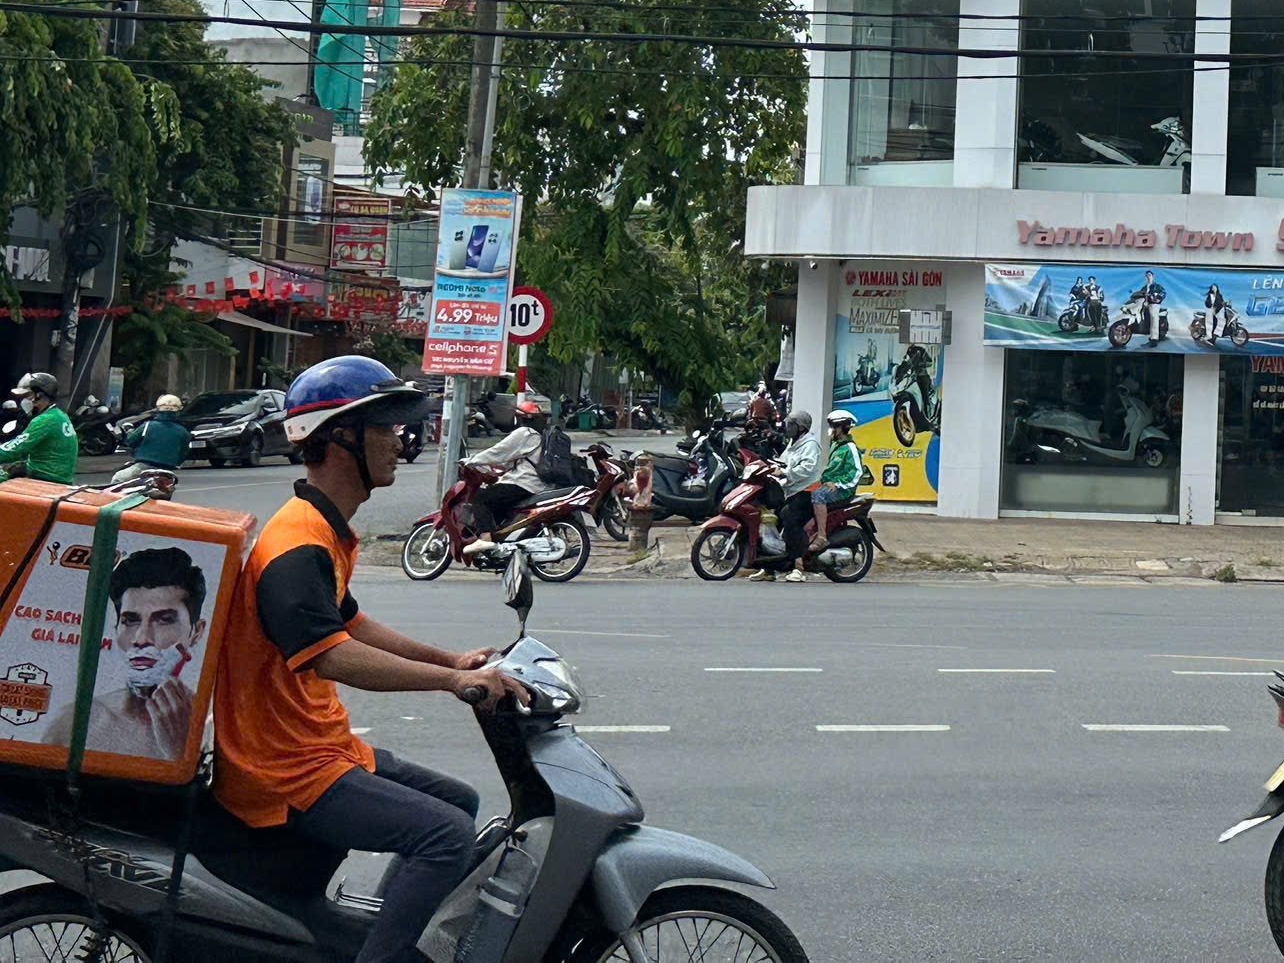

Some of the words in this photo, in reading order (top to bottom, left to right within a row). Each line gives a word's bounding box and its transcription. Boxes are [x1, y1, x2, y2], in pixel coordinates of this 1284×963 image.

[1016, 220, 1157, 248] Yamaha
[1165, 224, 1254, 251] Town
[859, 271, 898, 286] YAMAHA
[902, 269, 918, 286] SÀI
[1252, 276, 1284, 290] LÊN
[436, 307, 473, 323] 4.99
